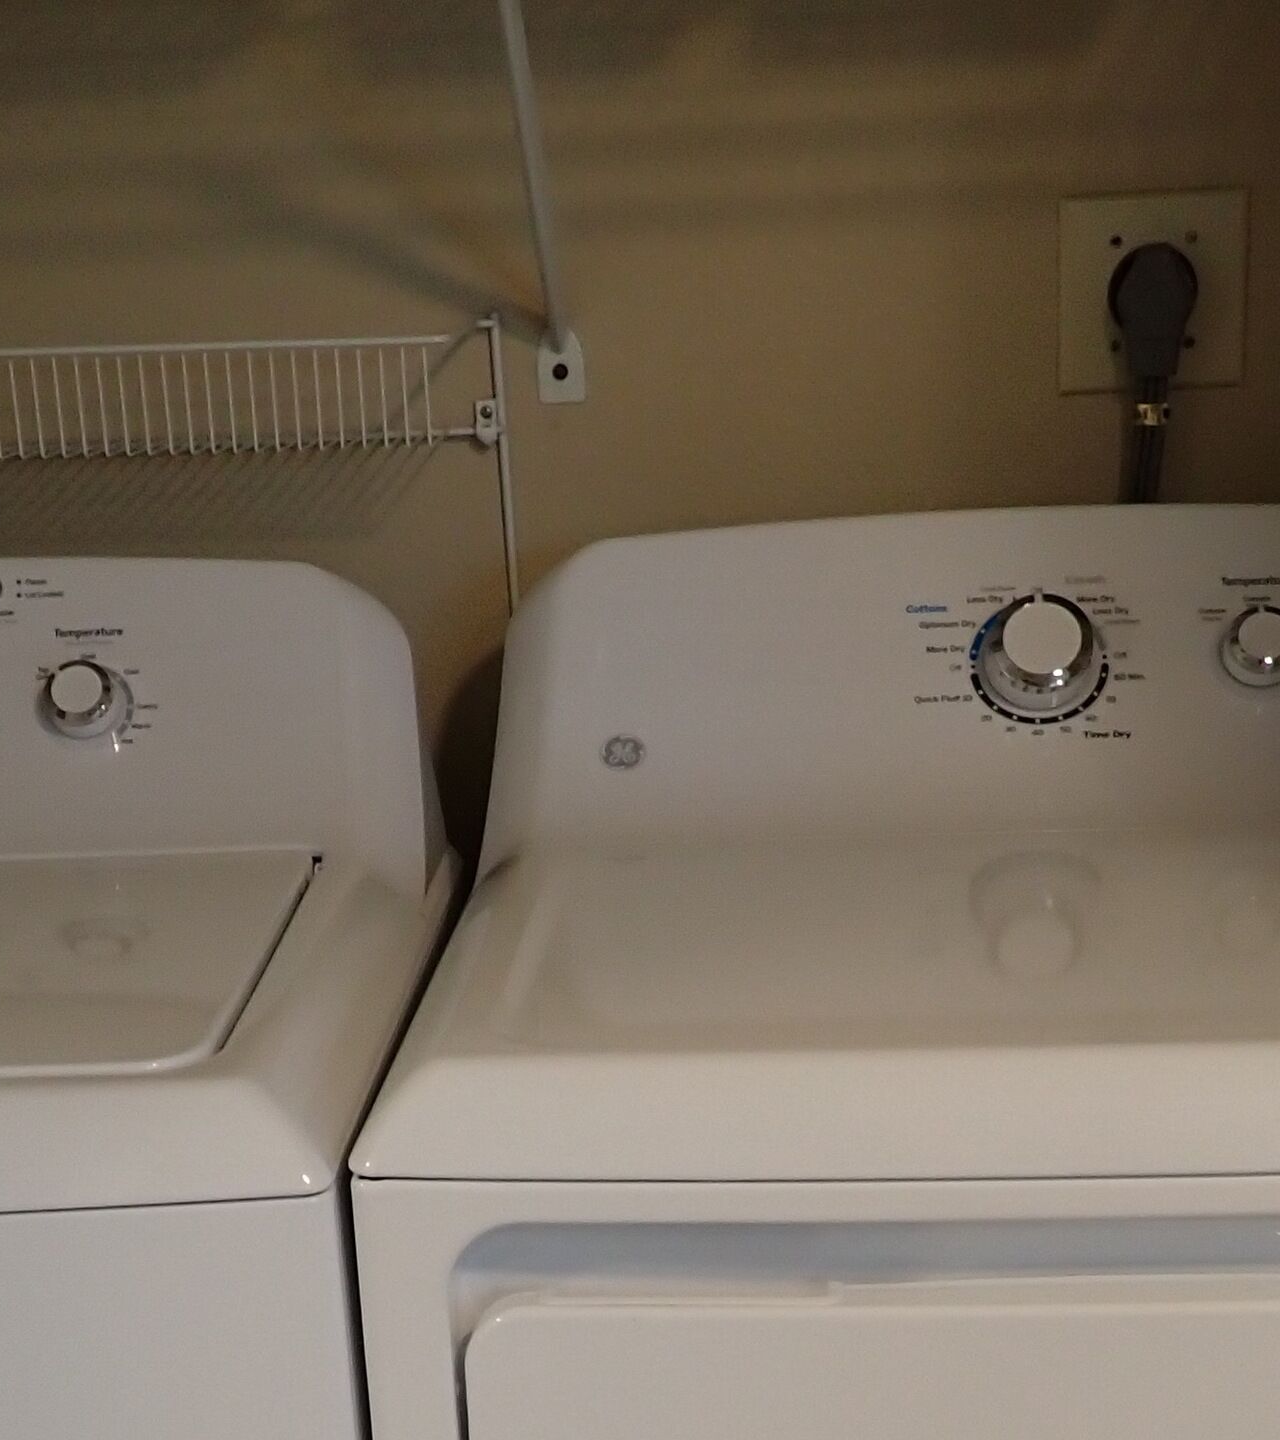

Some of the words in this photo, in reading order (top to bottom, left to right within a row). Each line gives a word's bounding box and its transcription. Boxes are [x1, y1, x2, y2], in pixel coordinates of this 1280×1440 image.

[55, 627, 124, 639] Temperature
[1084, 730, 1110, 739] Time
[1112, 729, 1131, 739] Dry
